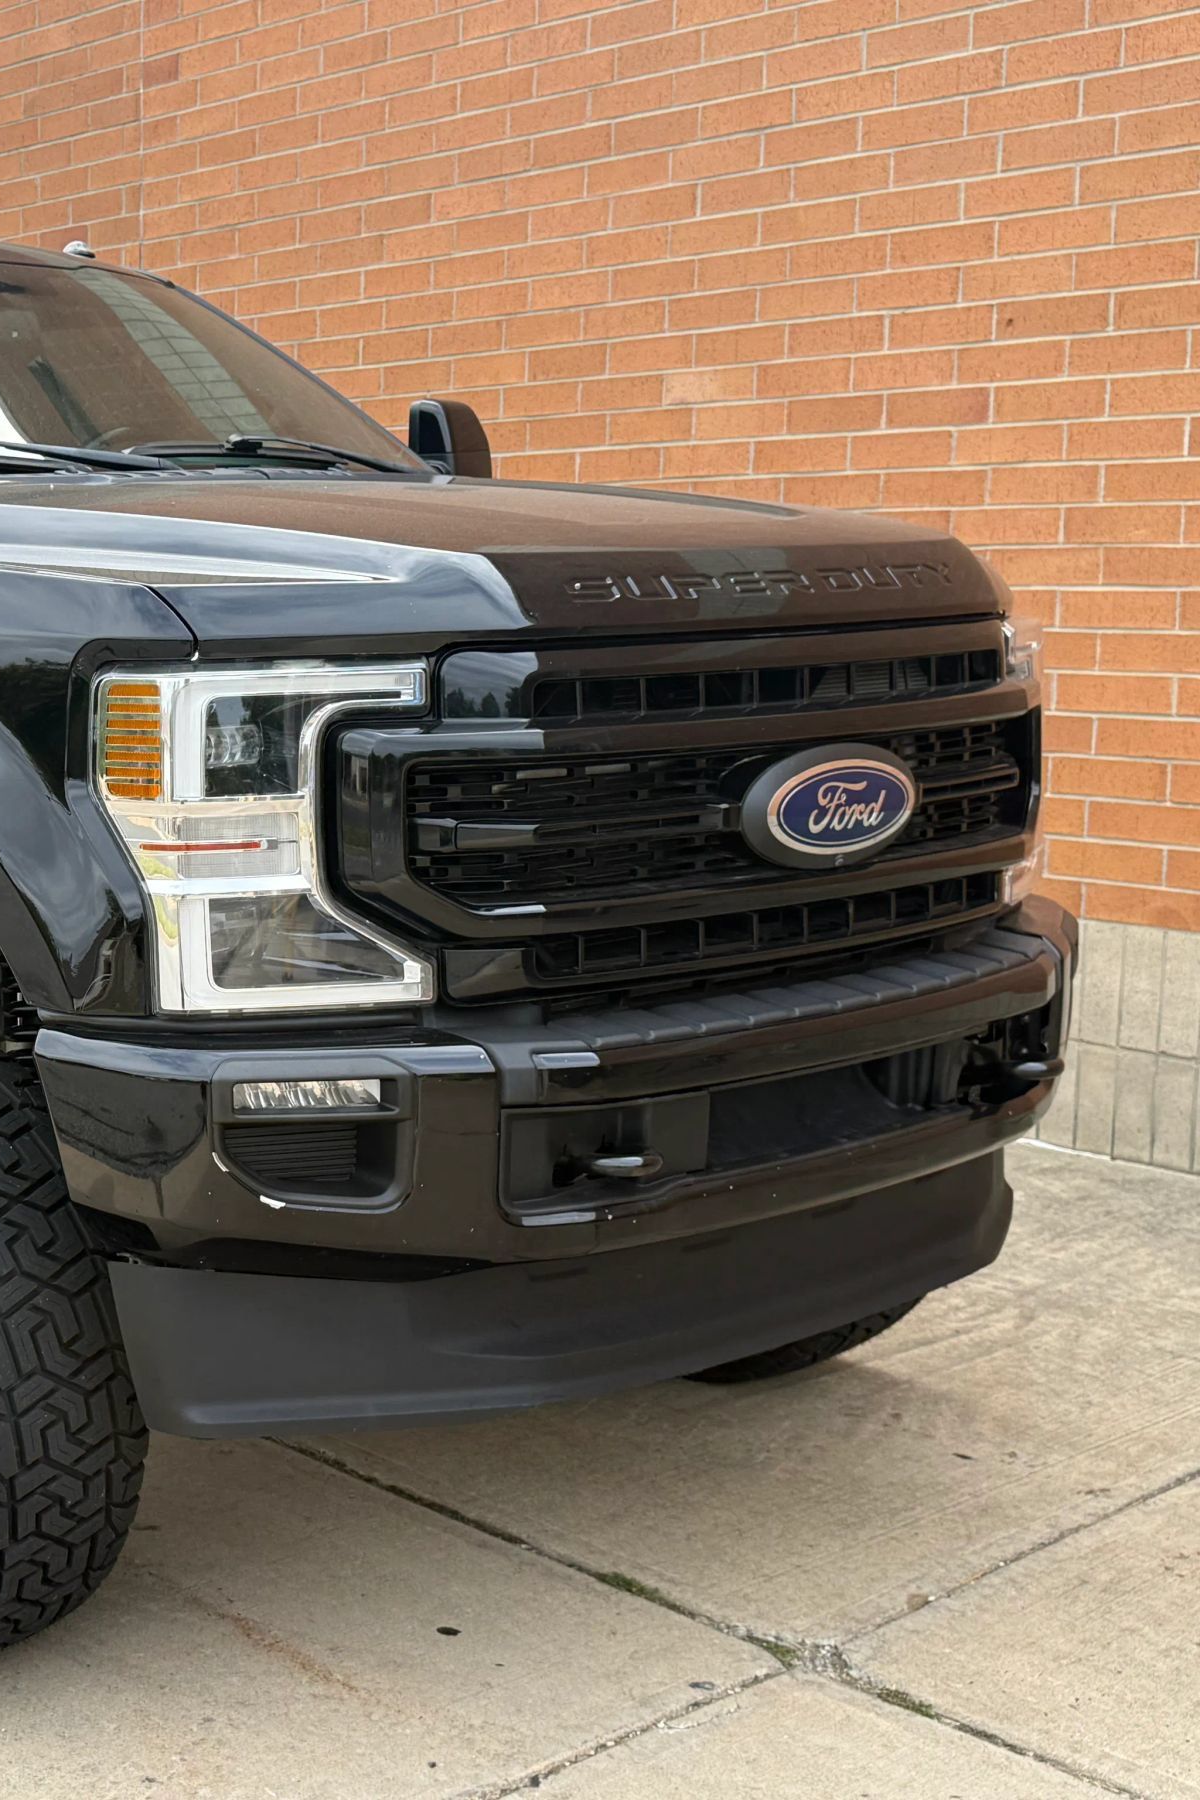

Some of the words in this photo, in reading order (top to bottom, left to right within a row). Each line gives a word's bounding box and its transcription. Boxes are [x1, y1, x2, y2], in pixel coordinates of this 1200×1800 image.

[564, 569, 815, 603] SUPER
[816, 562, 952, 593] DUTY
[808, 780, 887, 834] Ford
